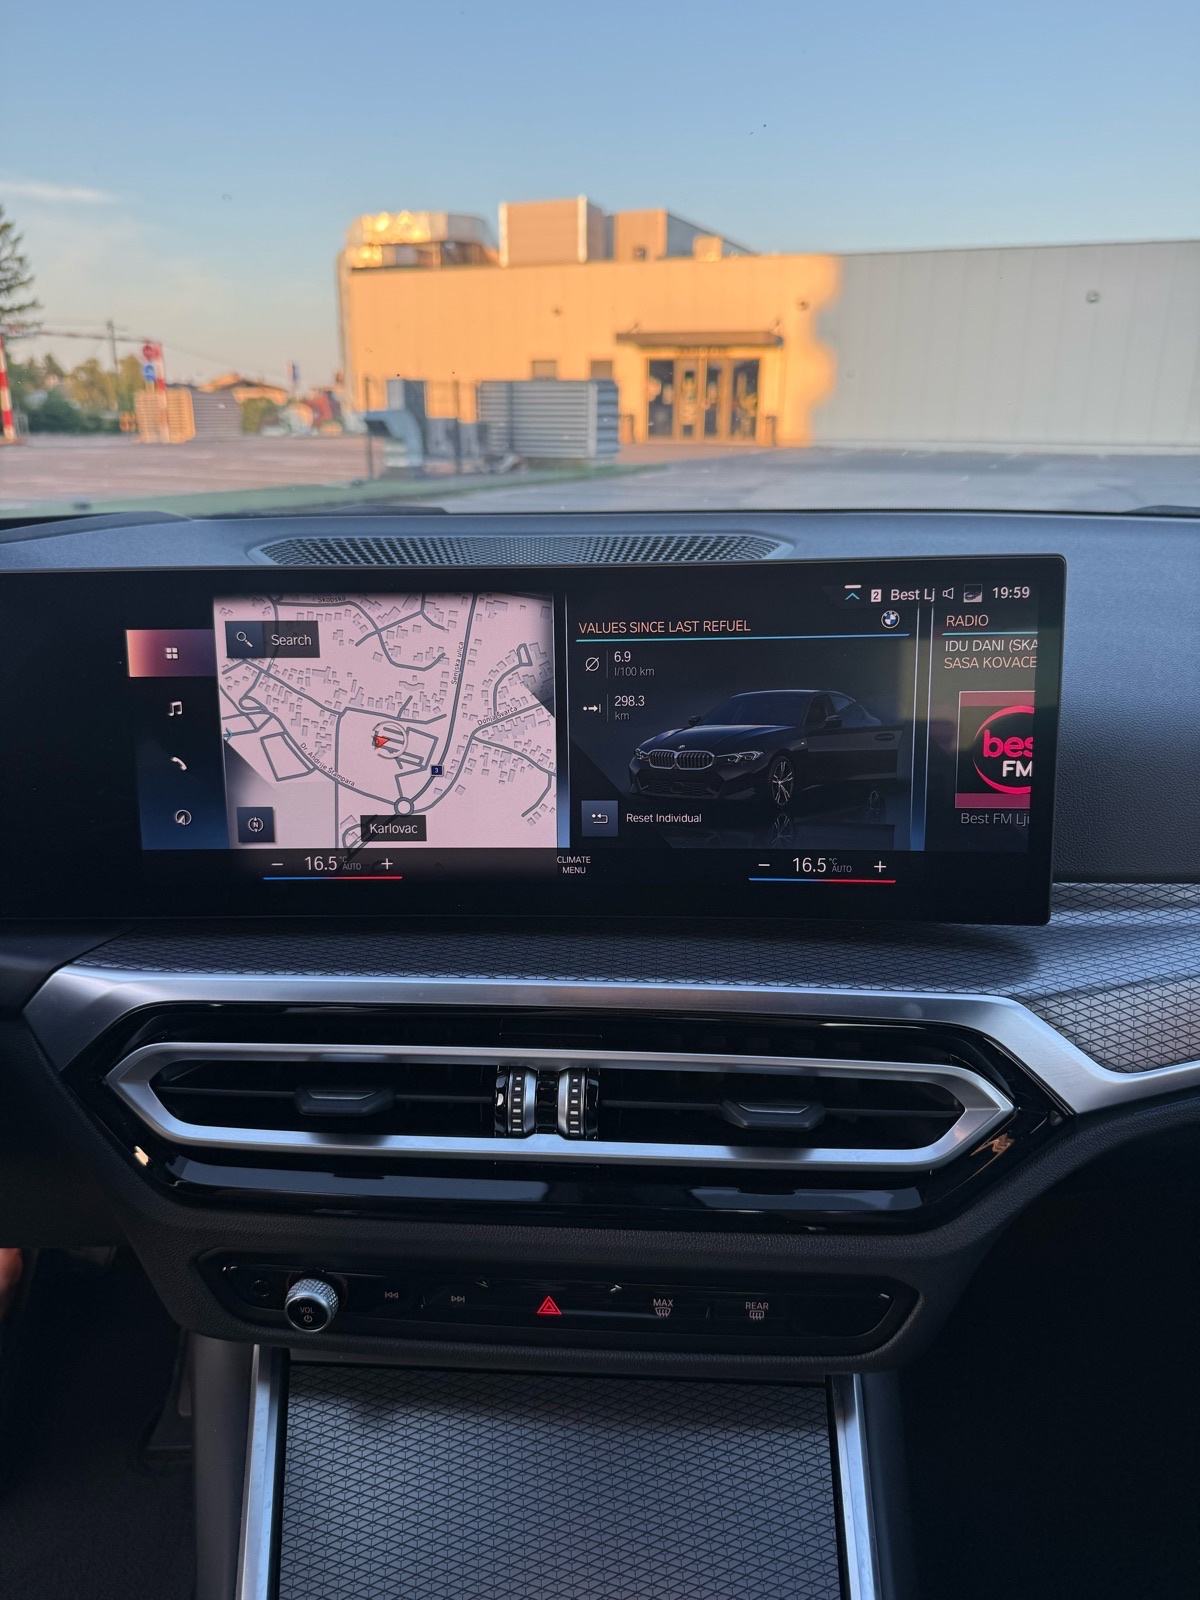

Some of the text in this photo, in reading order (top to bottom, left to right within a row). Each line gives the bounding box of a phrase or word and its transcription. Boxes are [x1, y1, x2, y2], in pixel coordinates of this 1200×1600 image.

[890, 589, 920, 601] Best
[924, 588, 935, 602] Lj
[992, 586, 1031, 599] 19:59
[578, 619, 751, 634] VALUES SINCE LAST REFUEL
[946, 614, 989, 627] RADIO
[271, 633, 312, 646] Search
[945, 640, 968, 652] IDU
[972, 639, 1005, 652] DANI
[614, 650, 632, 663] 6.9
[944, 656, 1037, 669] SASA KOVACE
[639, 666, 655, 677] km
[614, 695, 645, 707] 298.3
[614, 711, 630, 721] km
[1002, 760, 1033, 777] FM
[626, 813, 702, 823] Reset Individual
[960, 812, 990, 825] Best
[993, 812, 1012, 824] FM
[369, 823, 418, 835] Karlovac
[304, 856, 338, 871] 16.5
[556, 855, 591, 865] CLIMATE
[792, 857, 827, 873] 16.5
[342, 862, 362, 871] AUTO
[562, 865, 587, 874] MENU
[831, 864, 853, 873] AUTO
[653, 1298, 674, 1308] MAX
[745, 1301, 769, 1311] REAR
[300, 1306, 315, 1314] VOL
